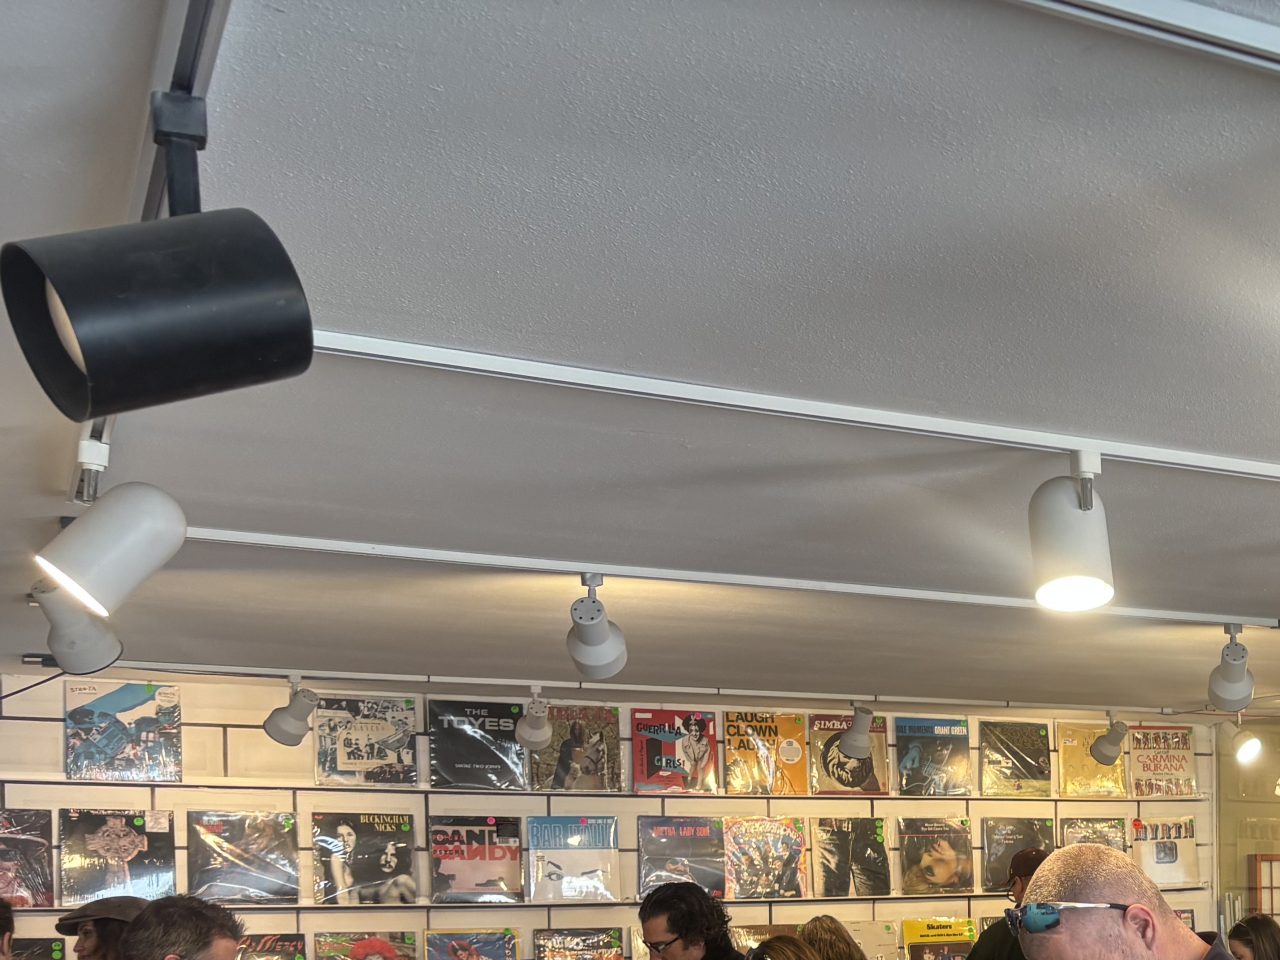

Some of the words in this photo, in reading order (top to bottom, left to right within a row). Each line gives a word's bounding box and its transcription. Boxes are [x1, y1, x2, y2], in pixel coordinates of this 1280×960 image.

[438, 716, 514, 730] TOYES
[725, 711, 775, 723] LAUGH
[636, 723, 682, 736] GUERRILLA
[726, 724, 779, 737] CLOWN
[813, 720, 848, 730] SIMBA
[934, 726, 950, 735] GRANT
[951, 727, 967, 735] GREEN
[726, 739, 775, 751] LAUH
[655, 756, 685, 768] GIRLS!
[1137, 755, 1188, 763] CARMINA
[1143, 763, 1184, 772] BURANA
[360, 815, 409, 823] BUCKINGHAM
[375, 823, 397, 832] NICKS
[530, 824, 563, 848] BAR
